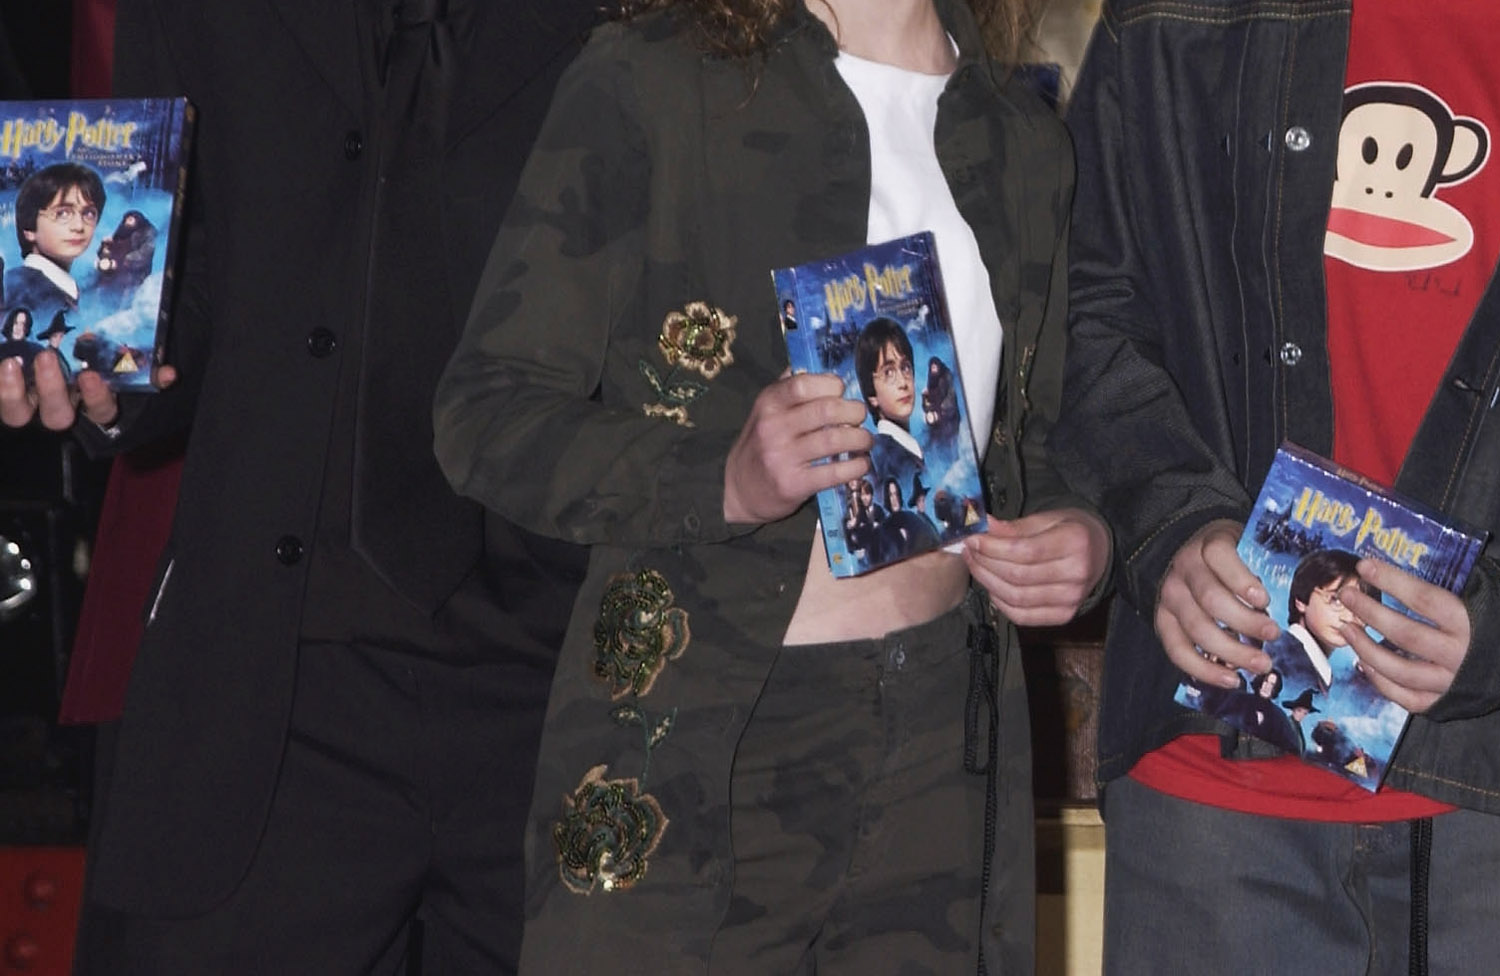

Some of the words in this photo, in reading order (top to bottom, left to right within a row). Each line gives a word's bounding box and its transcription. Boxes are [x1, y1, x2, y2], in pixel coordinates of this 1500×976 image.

[0, 118, 65, 160] Harry
[65, 111, 137, 160] Potter
[824, 274, 866, 323] Harry
[863, 262, 914, 313] Potter
[1292, 486, 1359, 537] Harry
[1354, 508, 1429, 567] Potter
